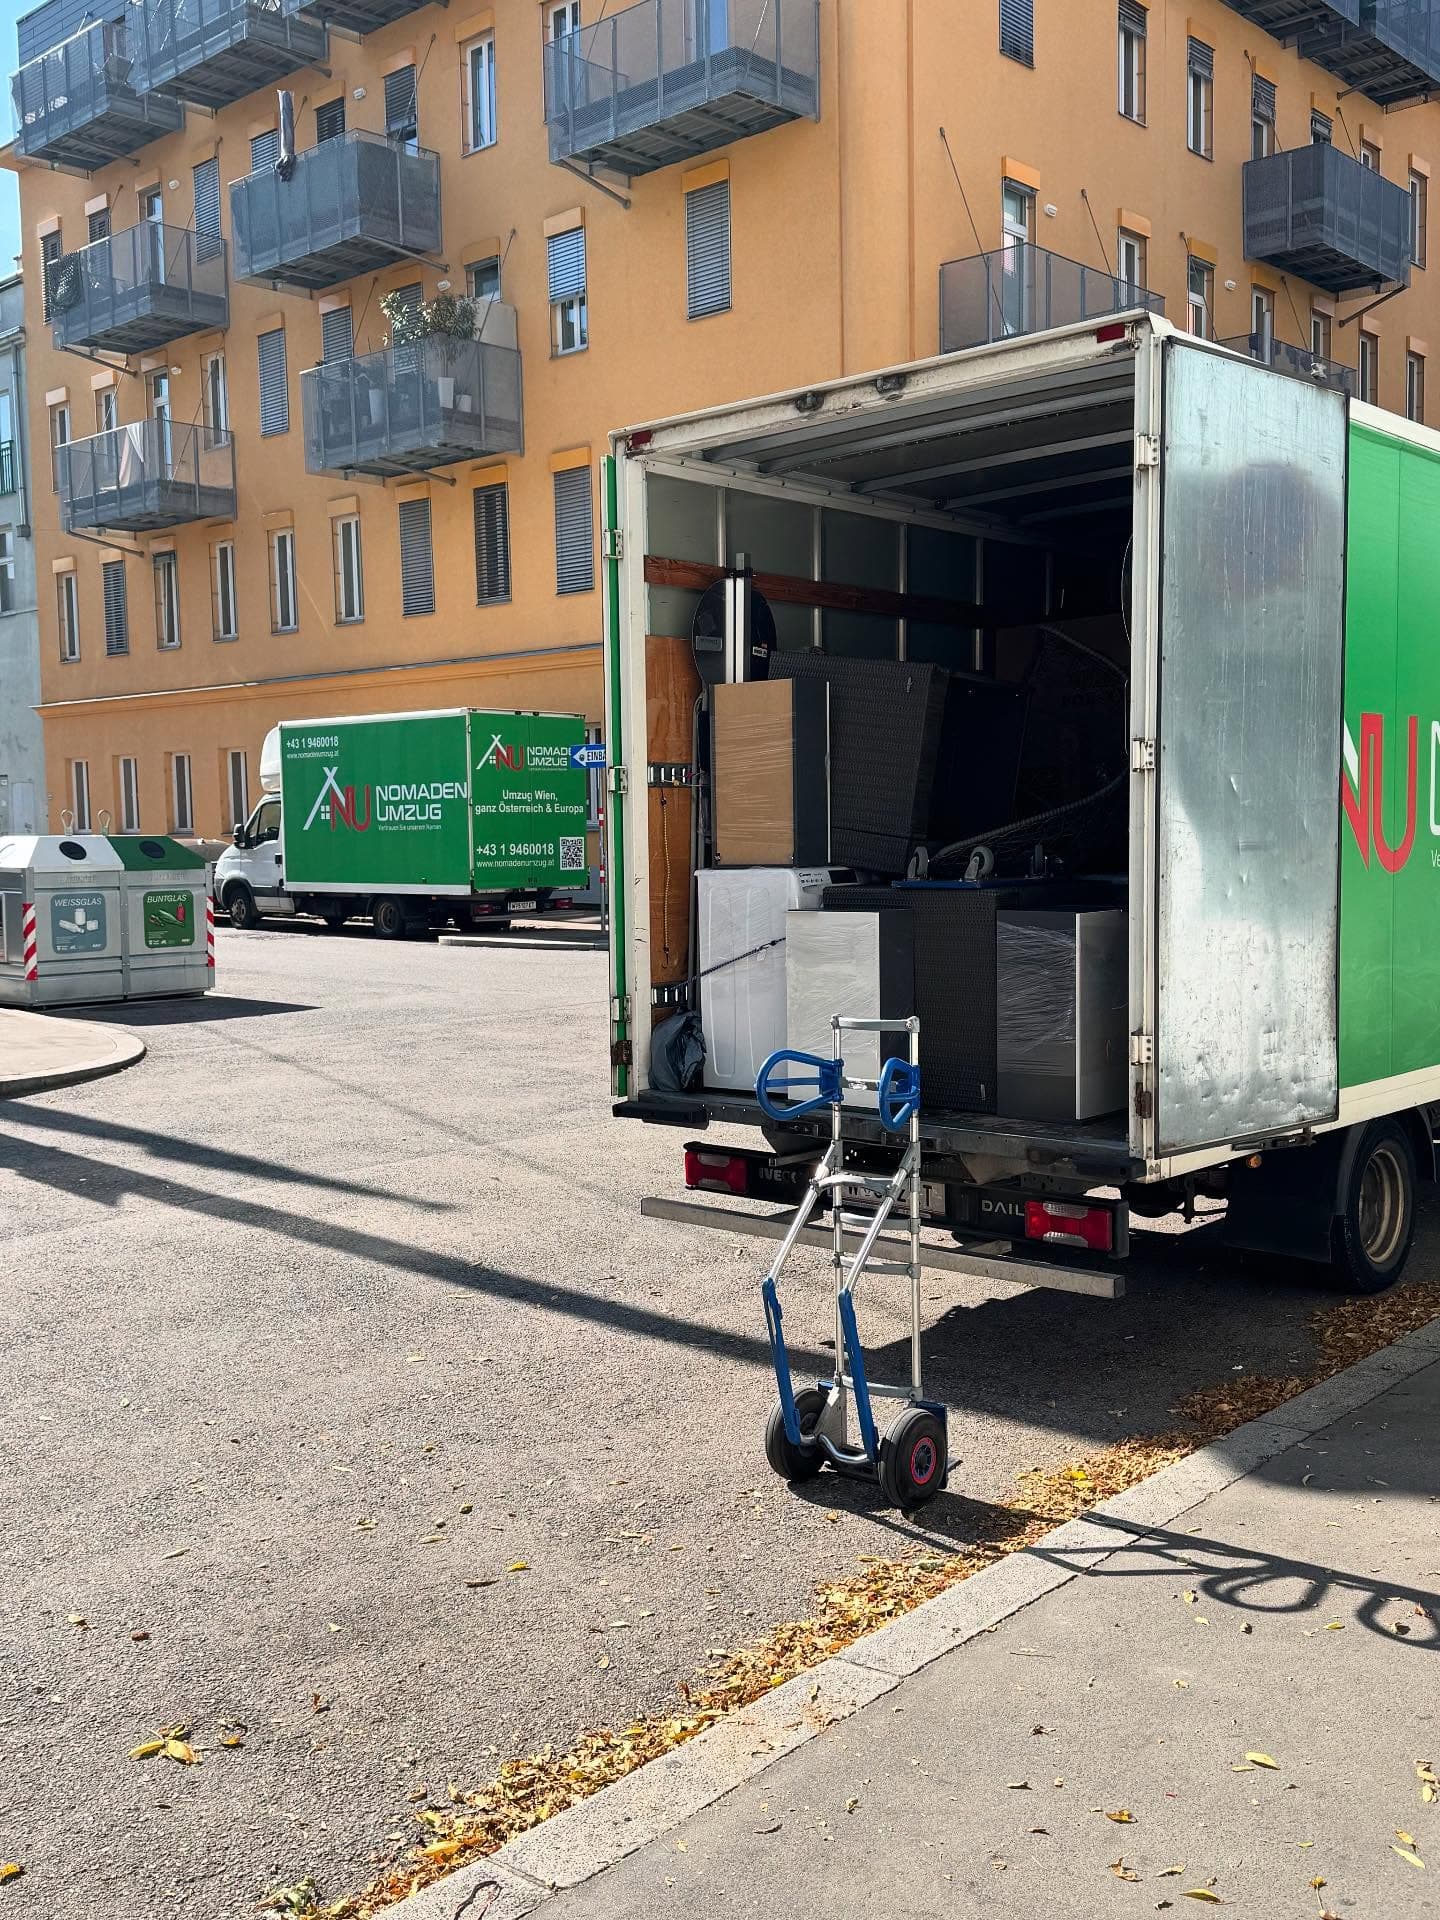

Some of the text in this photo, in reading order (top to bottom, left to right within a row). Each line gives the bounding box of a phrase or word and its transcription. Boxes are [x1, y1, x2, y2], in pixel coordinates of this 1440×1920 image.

[286, 735, 339, 749] +43 1 9460018
[527, 756, 568, 767] UMZUG
[375, 782, 468, 801] NOMADEN
[502, 789, 558, 802] Umzug Wien,
[376, 802, 442, 822] UMZUG
[475, 801, 584, 815] ganz Österreich & Europa
[476, 843, 555, 856] +43 1 9460018
[54, 897, 102, 907] WEISSGLAS
[147, 894, 188, 903] BUNTGLAS
